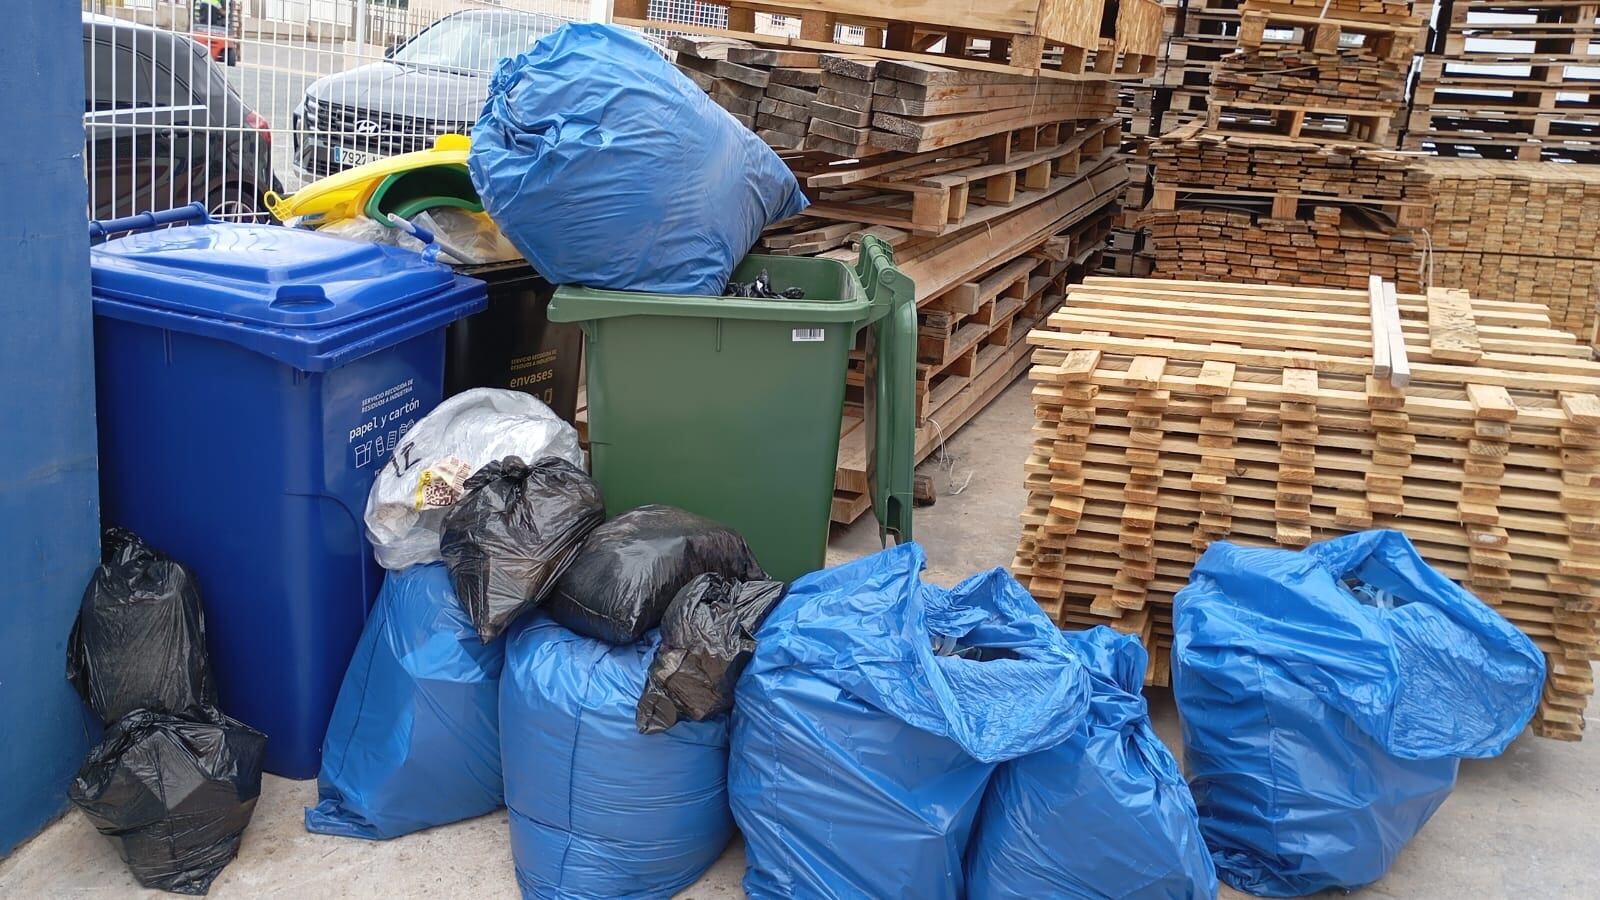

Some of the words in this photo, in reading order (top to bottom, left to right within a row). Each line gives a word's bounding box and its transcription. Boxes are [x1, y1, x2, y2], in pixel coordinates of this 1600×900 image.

[510, 369, 553, 388] envases
[361, 400, 385, 413] RESIDUOS
[389, 386, 413, 401] INDUSTRIA
[362, 392, 385, 406] SERVICIO
[385, 382, 407, 396] RECOGIDA
[349, 417, 377, 443] papel
[381, 414, 387, 429] y
[389, 398, 419, 421] cartón
